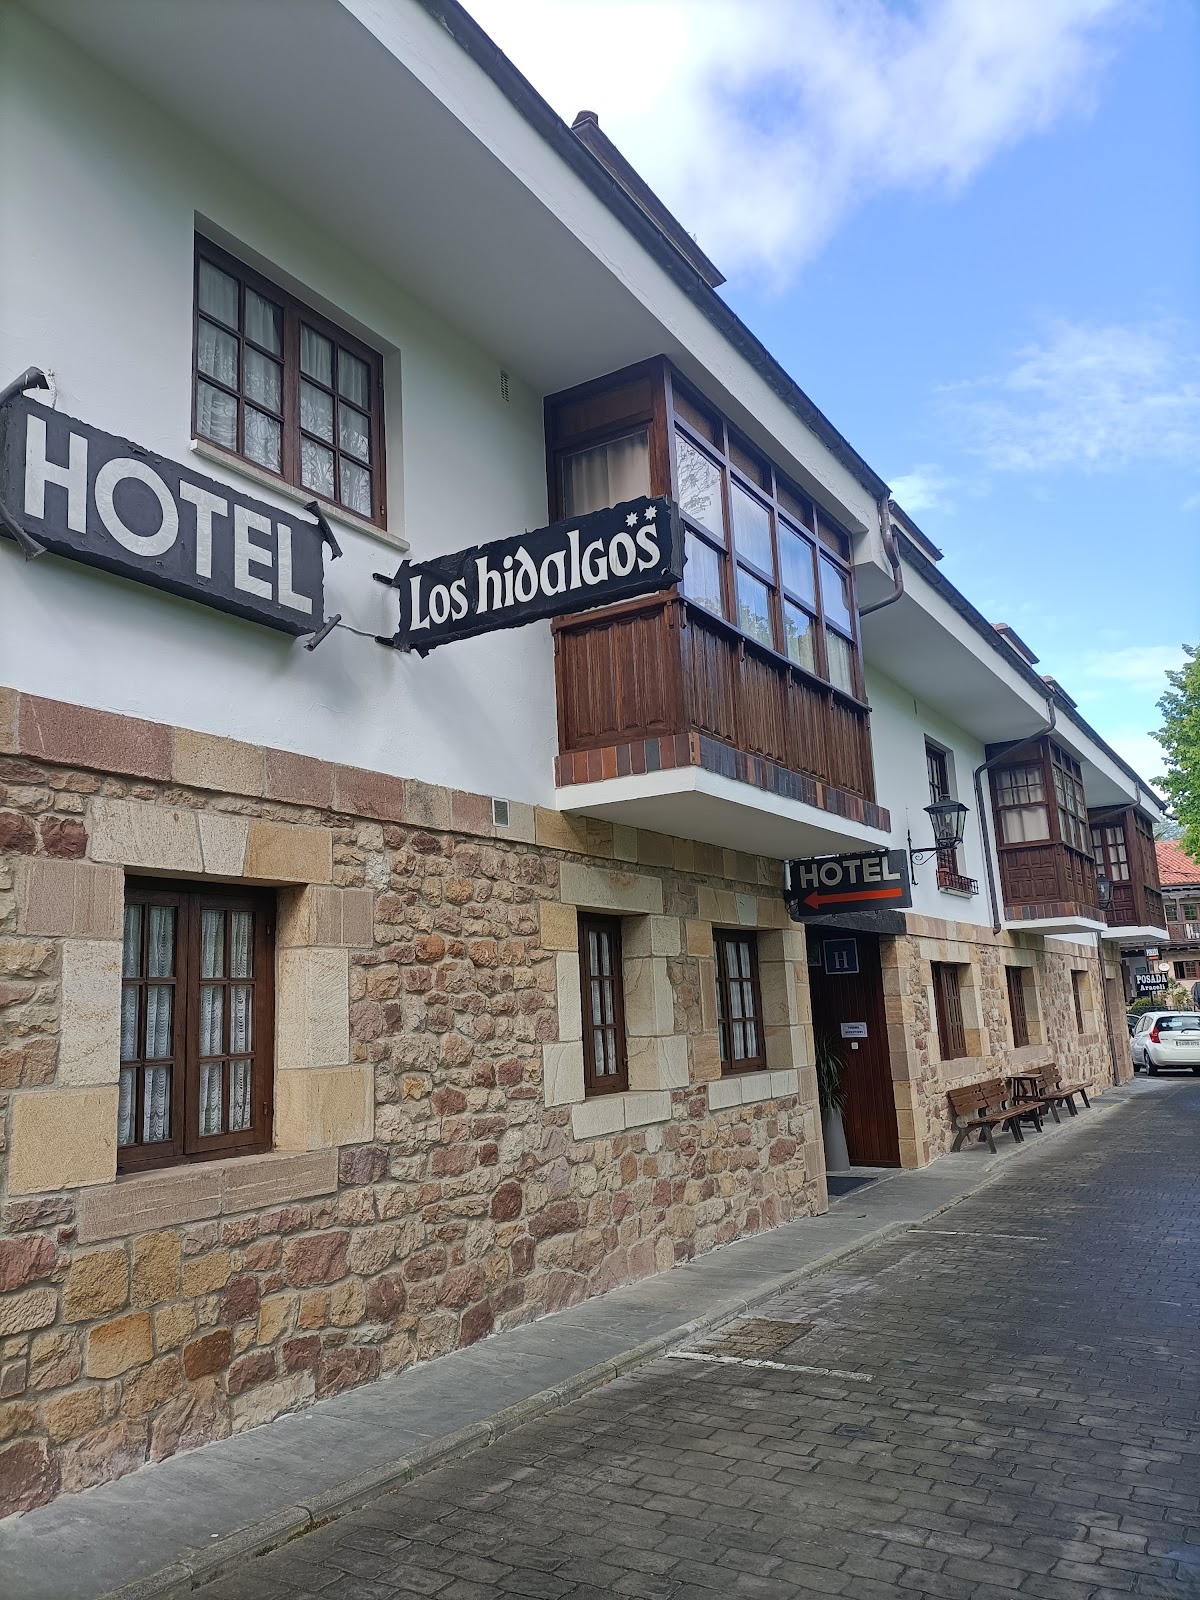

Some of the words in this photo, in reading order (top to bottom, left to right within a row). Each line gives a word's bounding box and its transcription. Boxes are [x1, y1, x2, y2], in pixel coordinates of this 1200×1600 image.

[24, 413, 313, 615] HOTEL
[410, 573, 469, 631] Los
[800, 856, 901, 889] HOTEL
[833, 950, 849, 969] H
[1136, 974, 1167, 984] POSADA
